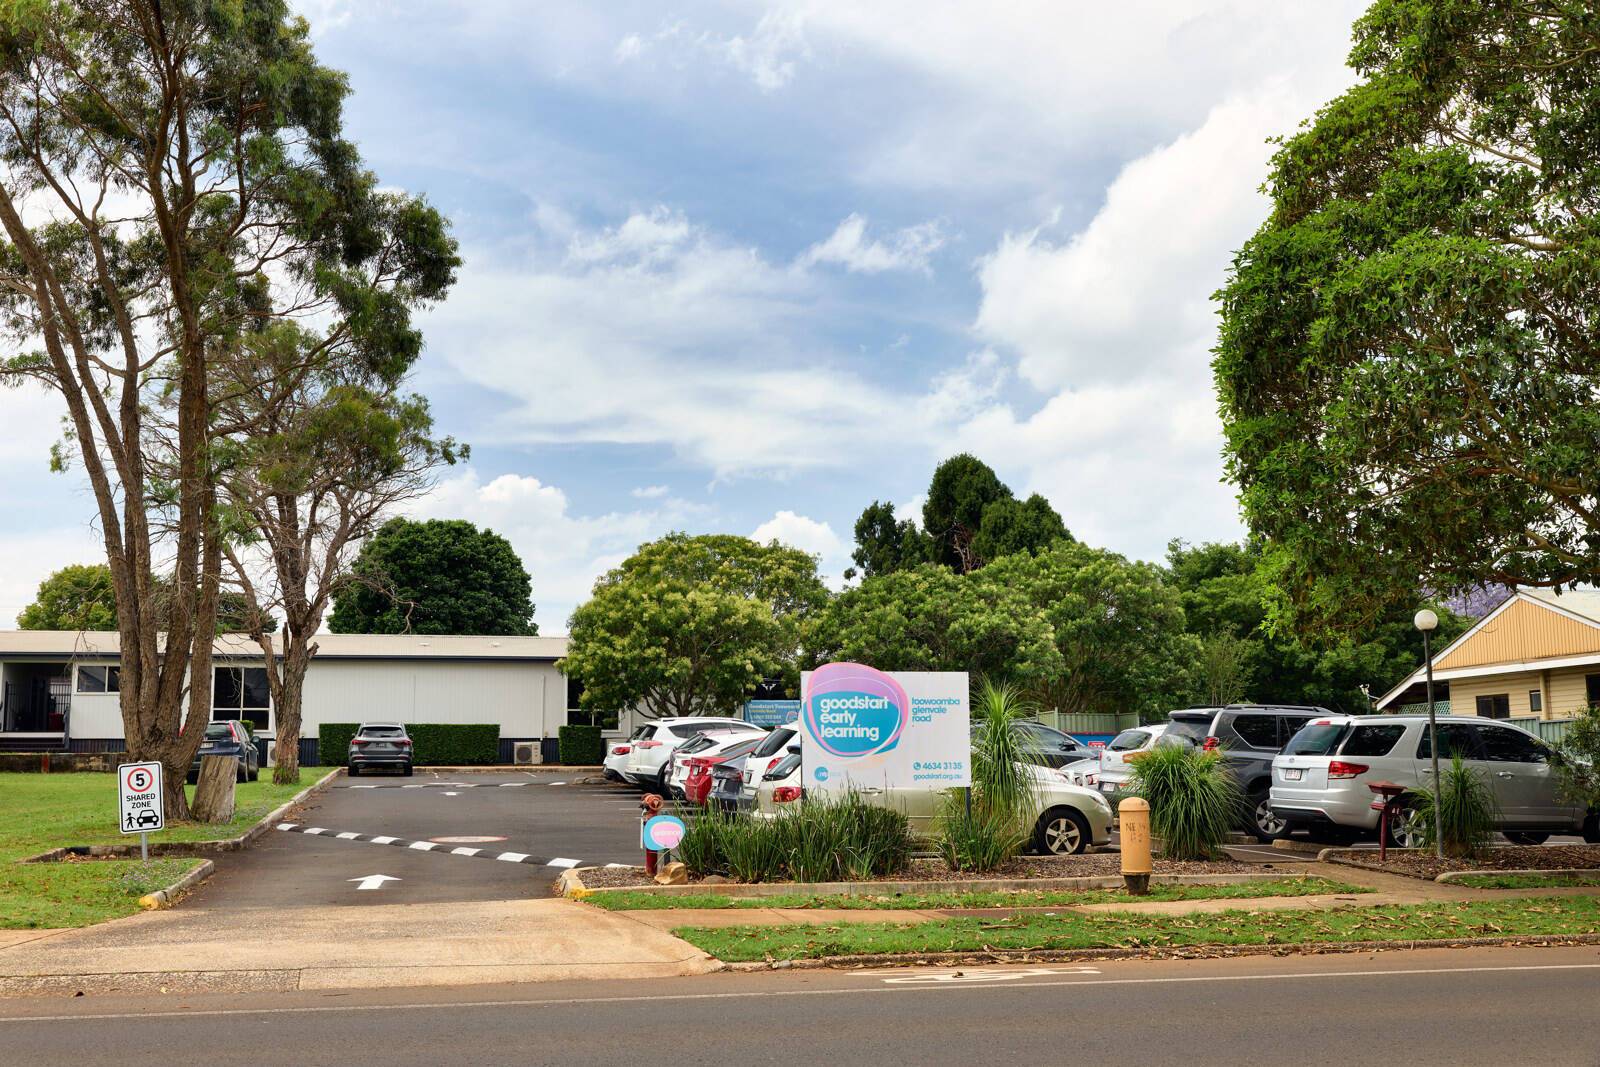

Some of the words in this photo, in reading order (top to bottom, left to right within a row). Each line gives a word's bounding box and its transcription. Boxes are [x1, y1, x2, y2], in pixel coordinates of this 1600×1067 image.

[820, 696, 889, 713] goodstart
[911, 697, 960, 705] toowoomba
[911, 706, 947, 715] glenvale
[820, 710, 857, 726] early
[911, 714, 932, 722] road
[820, 725, 879, 741] learning
[922, 762, 942, 770] 4634
[943, 762, 962, 770] 3135
[135, 773, 145, 787] 5
[913, 773, 963, 781] goodstart.org.au
[126, 793, 156, 802] SHARED
[131, 801, 152, 809] ZONE
